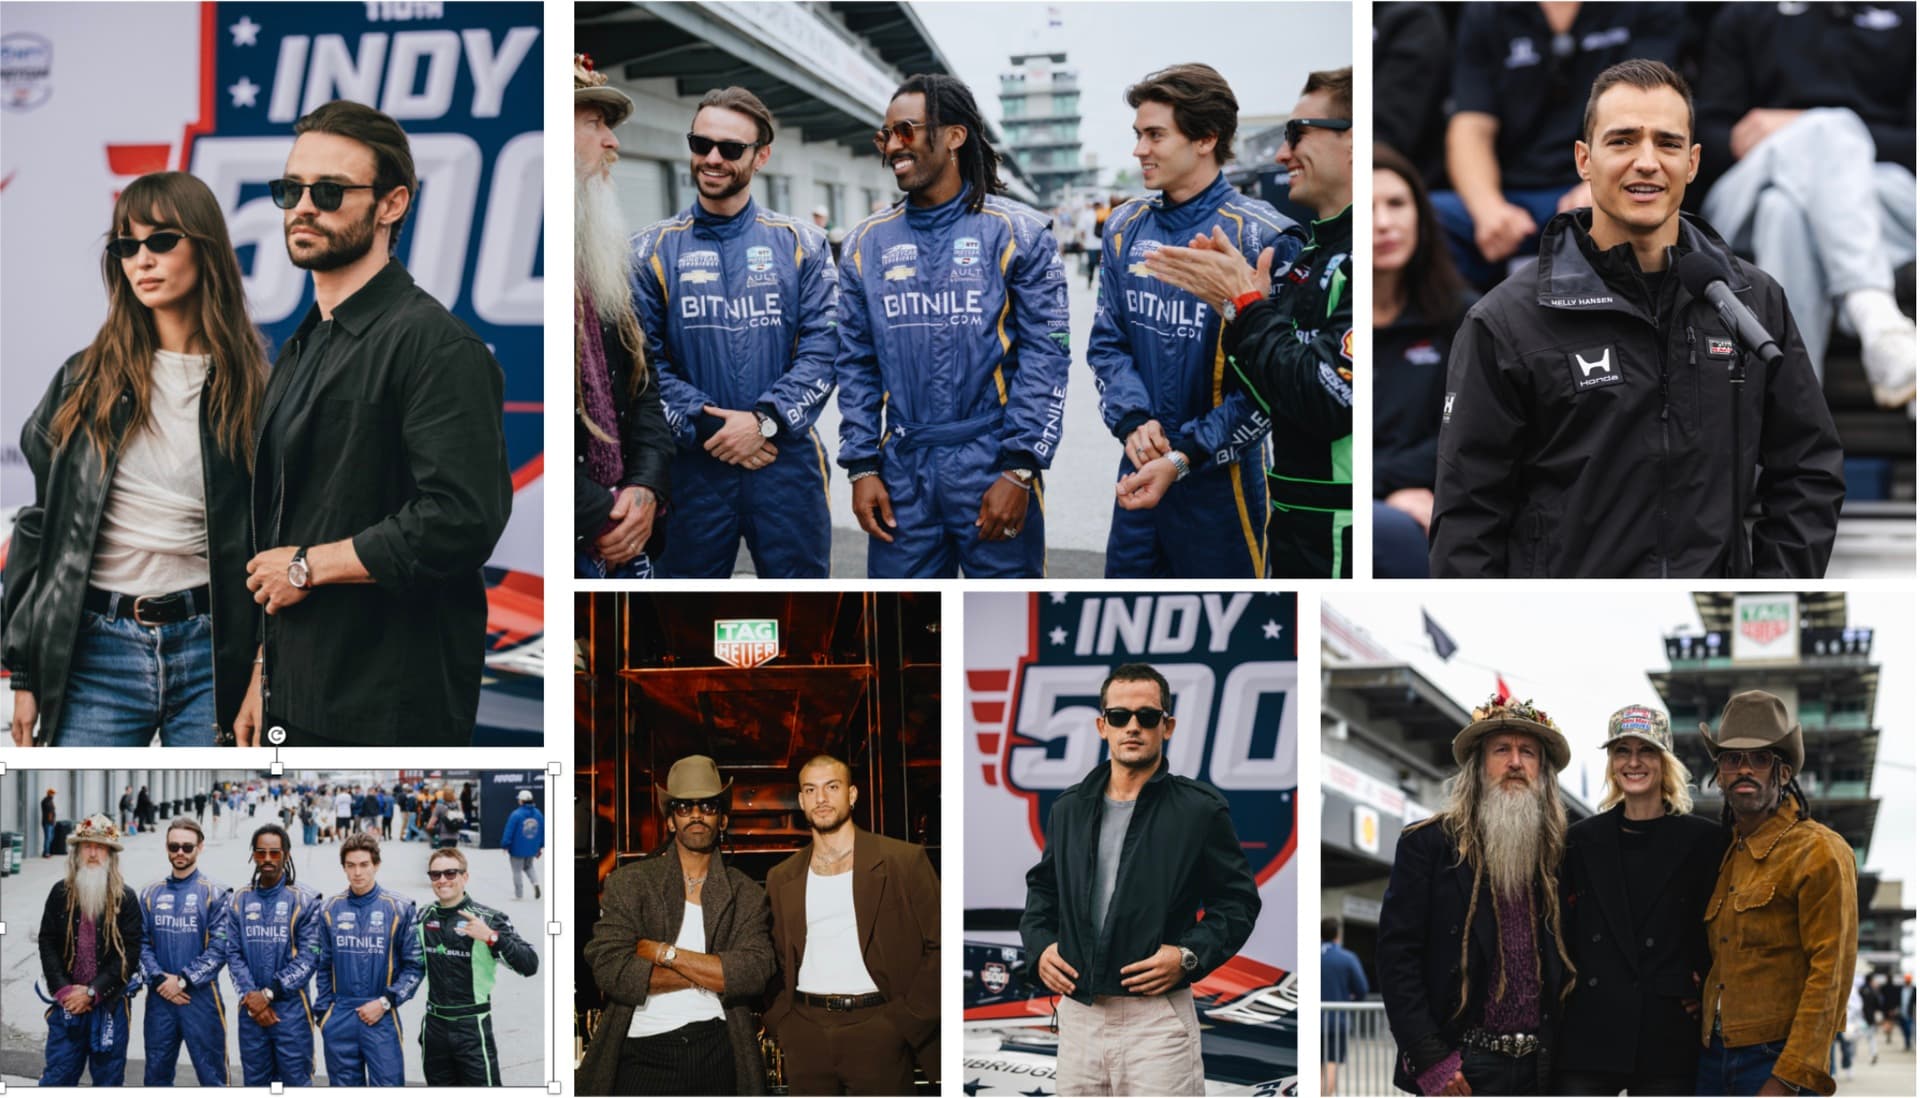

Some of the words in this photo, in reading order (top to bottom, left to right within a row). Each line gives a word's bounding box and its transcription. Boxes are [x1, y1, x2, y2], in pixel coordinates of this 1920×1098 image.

[268, 27, 541, 122] INDY
[747, 273, 778, 284] AULT
[950, 268, 983, 279] AULT
[681, 293, 782, 319] BITNILE
[883, 290, 983, 318] BITNILE
[1126, 290, 1207, 327] BITNILE
[1579, 297, 1613, 305] HANSEN
[745, 316, 782, 330] .COM
[1580, 375, 1619, 387] Honda
[1033, 385, 1066, 456] BITNILE
[717, 623, 773, 641] TAG
[1075, 592, 1253, 656] INDY
[718, 642, 775, 668] HEUER
[336, 935, 385, 949] BITNILE
